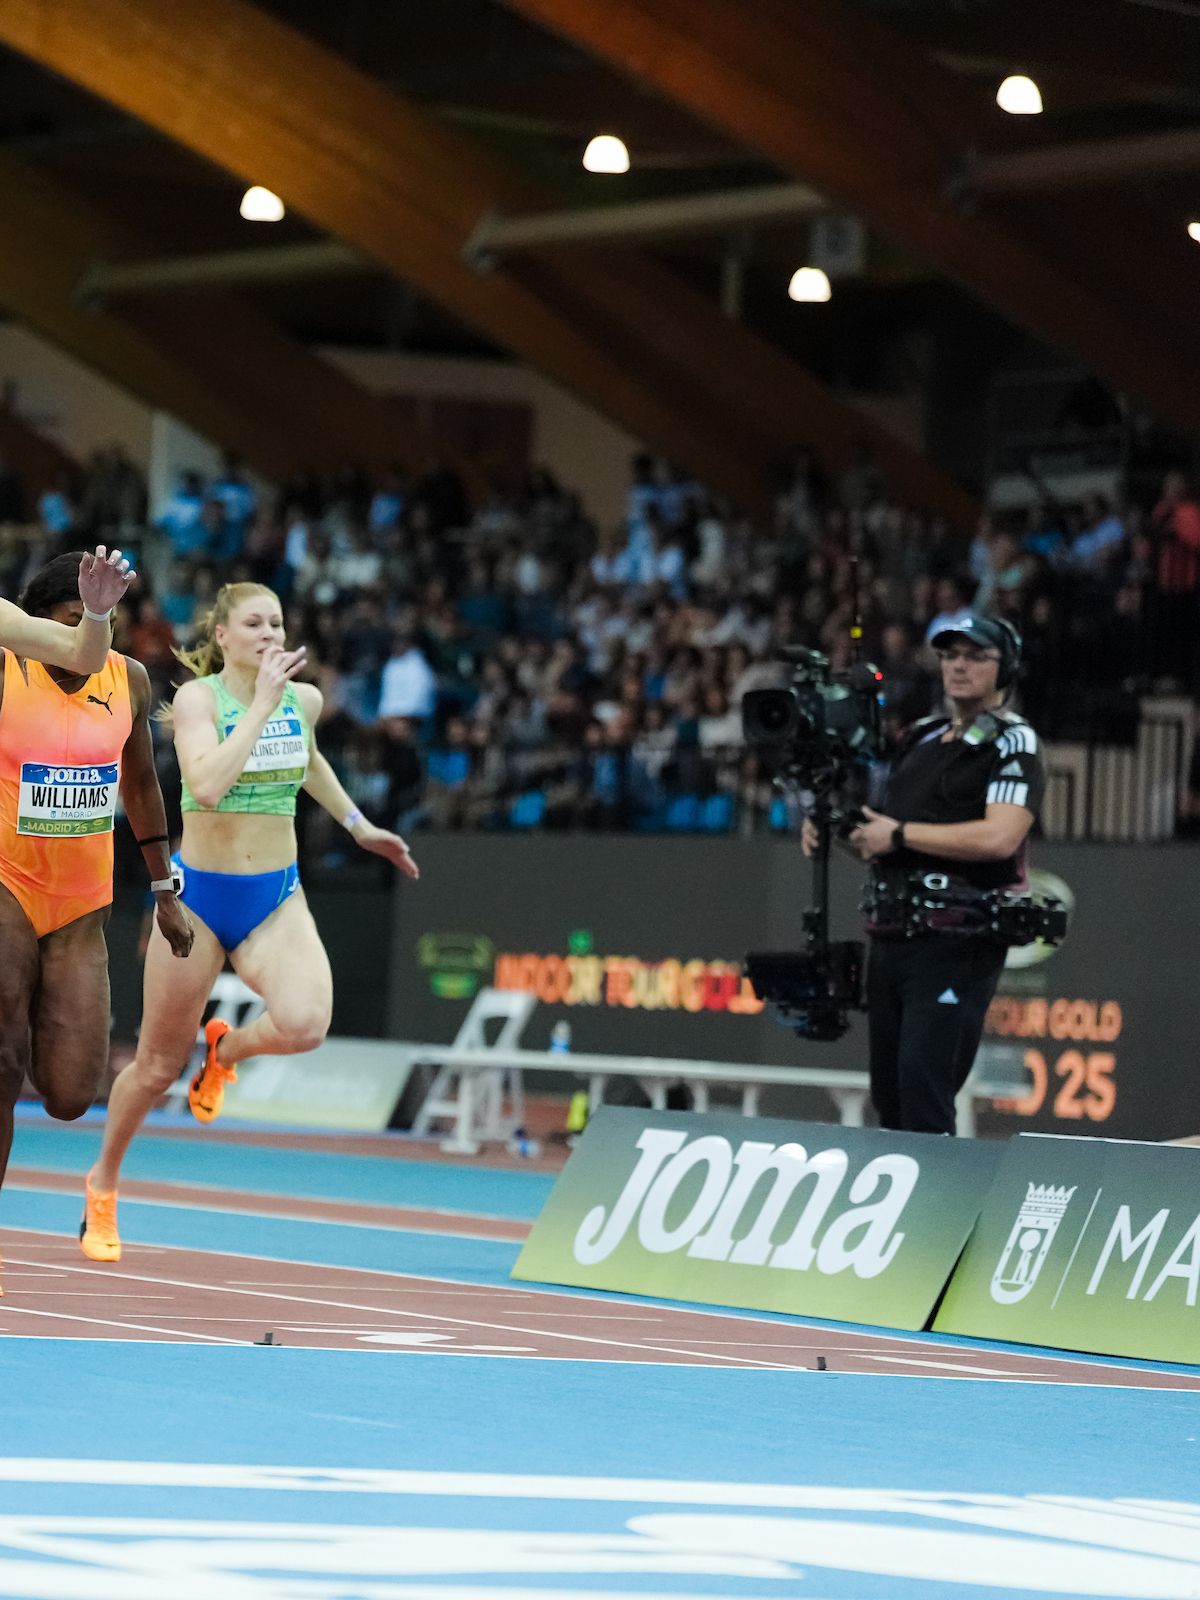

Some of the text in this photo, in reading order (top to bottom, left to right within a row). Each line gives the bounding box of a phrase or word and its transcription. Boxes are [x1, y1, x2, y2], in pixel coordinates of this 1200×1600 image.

[251, 742, 280, 757] LINEC
[31, 785, 109, 809] WILLIAMS
[61, 811, 93, 819] MADRID
[27, 821, 88, 833] MADRID 25
[1053, 1048, 1118, 1122] 25
